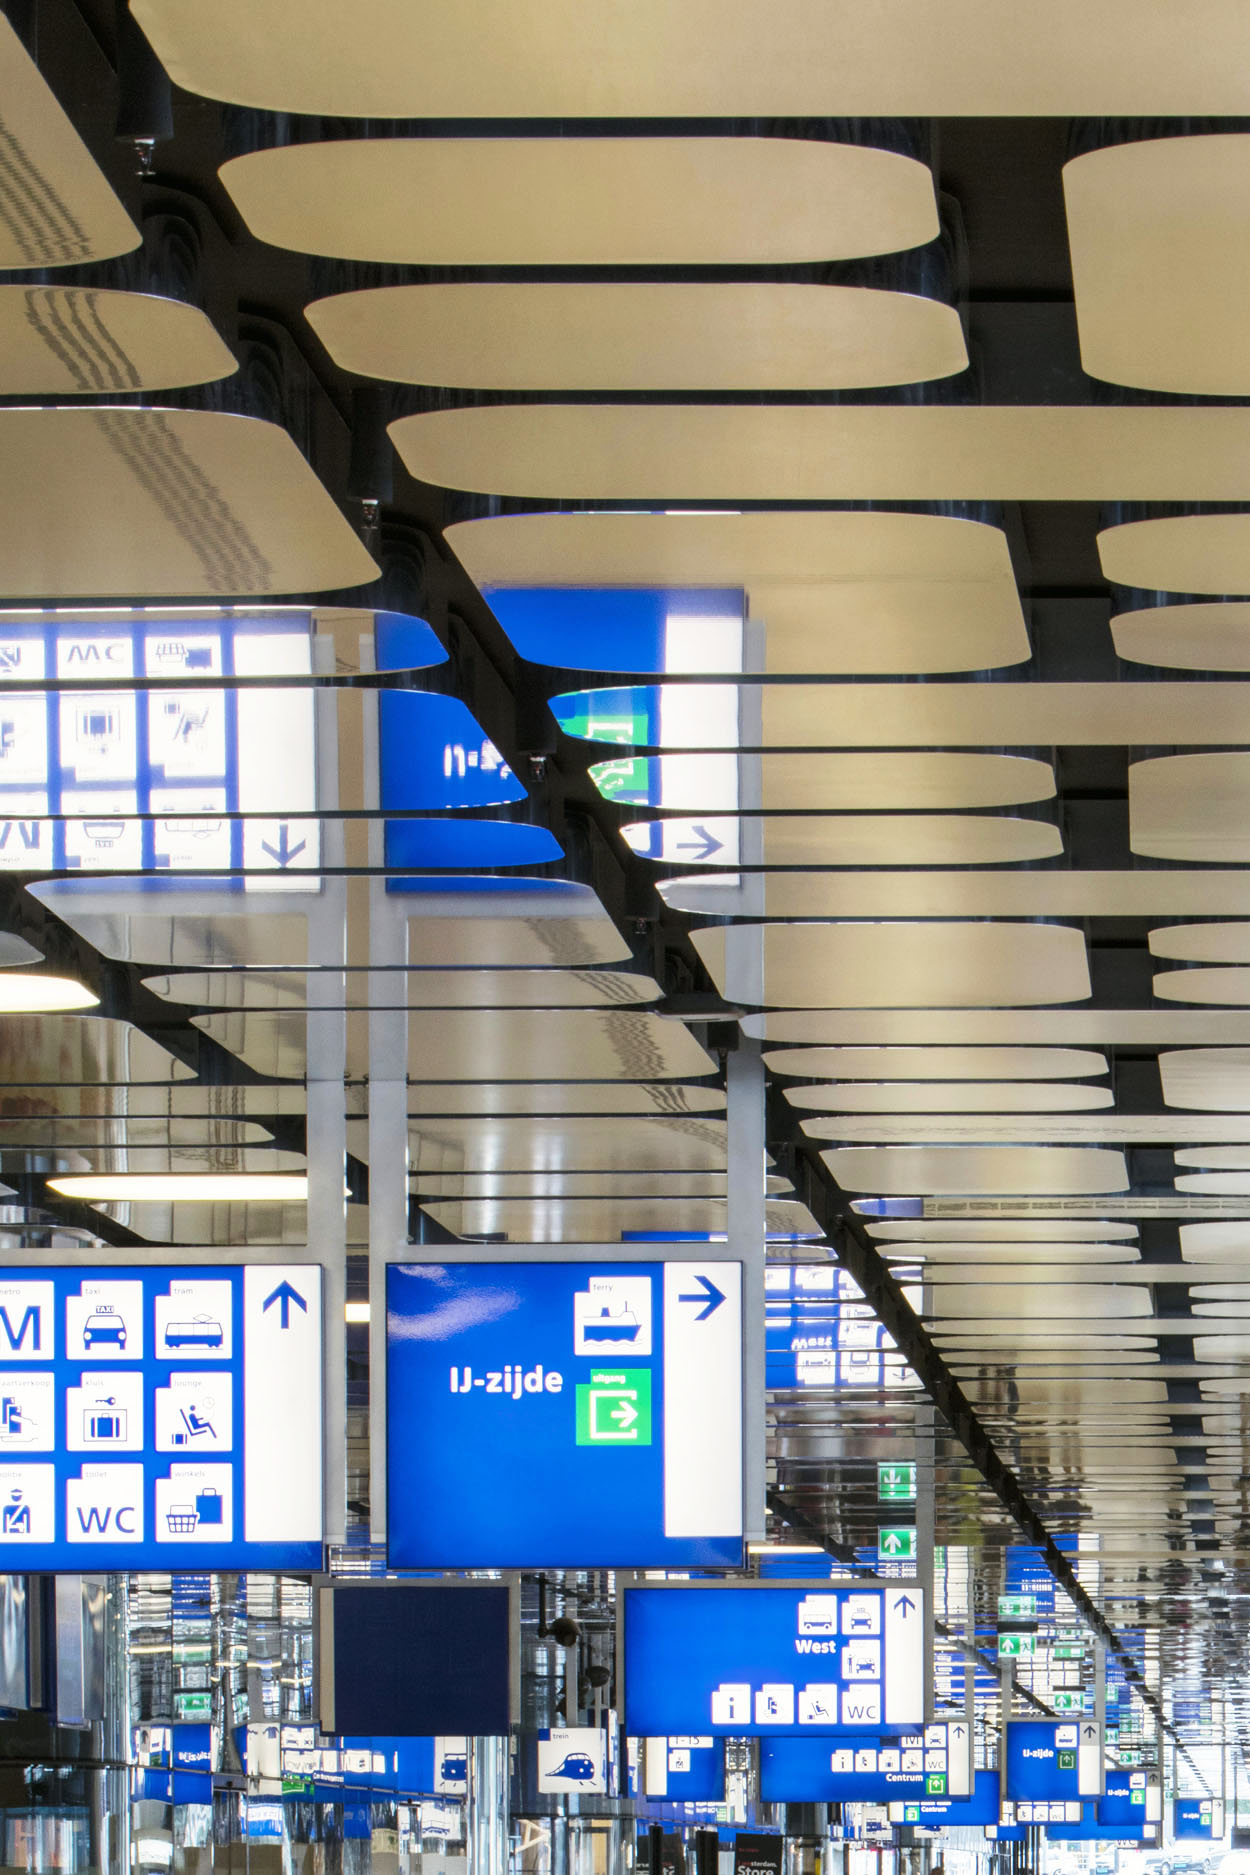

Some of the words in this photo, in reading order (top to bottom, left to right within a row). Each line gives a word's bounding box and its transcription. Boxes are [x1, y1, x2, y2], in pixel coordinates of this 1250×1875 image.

[593, 1283, 614, 1293] ferry
[95, 1305, 114, 1314] TAXI
[0, 1305, 41, 1351] M
[0, 1379, 51, 1388] aartverkoop
[450, 1365, 564, 1400] IJ-zijde
[592, 1373, 626, 1384] uitgang
[174, 1470, 206, 1478] winkels
[76, 1506, 135, 1534] WC
[795, 1639, 837, 1654] West
[847, 1705, 876, 1719] WC
[928, 1761, 944, 1769] WC
[886, 1773, 923, 1782] Centrum
